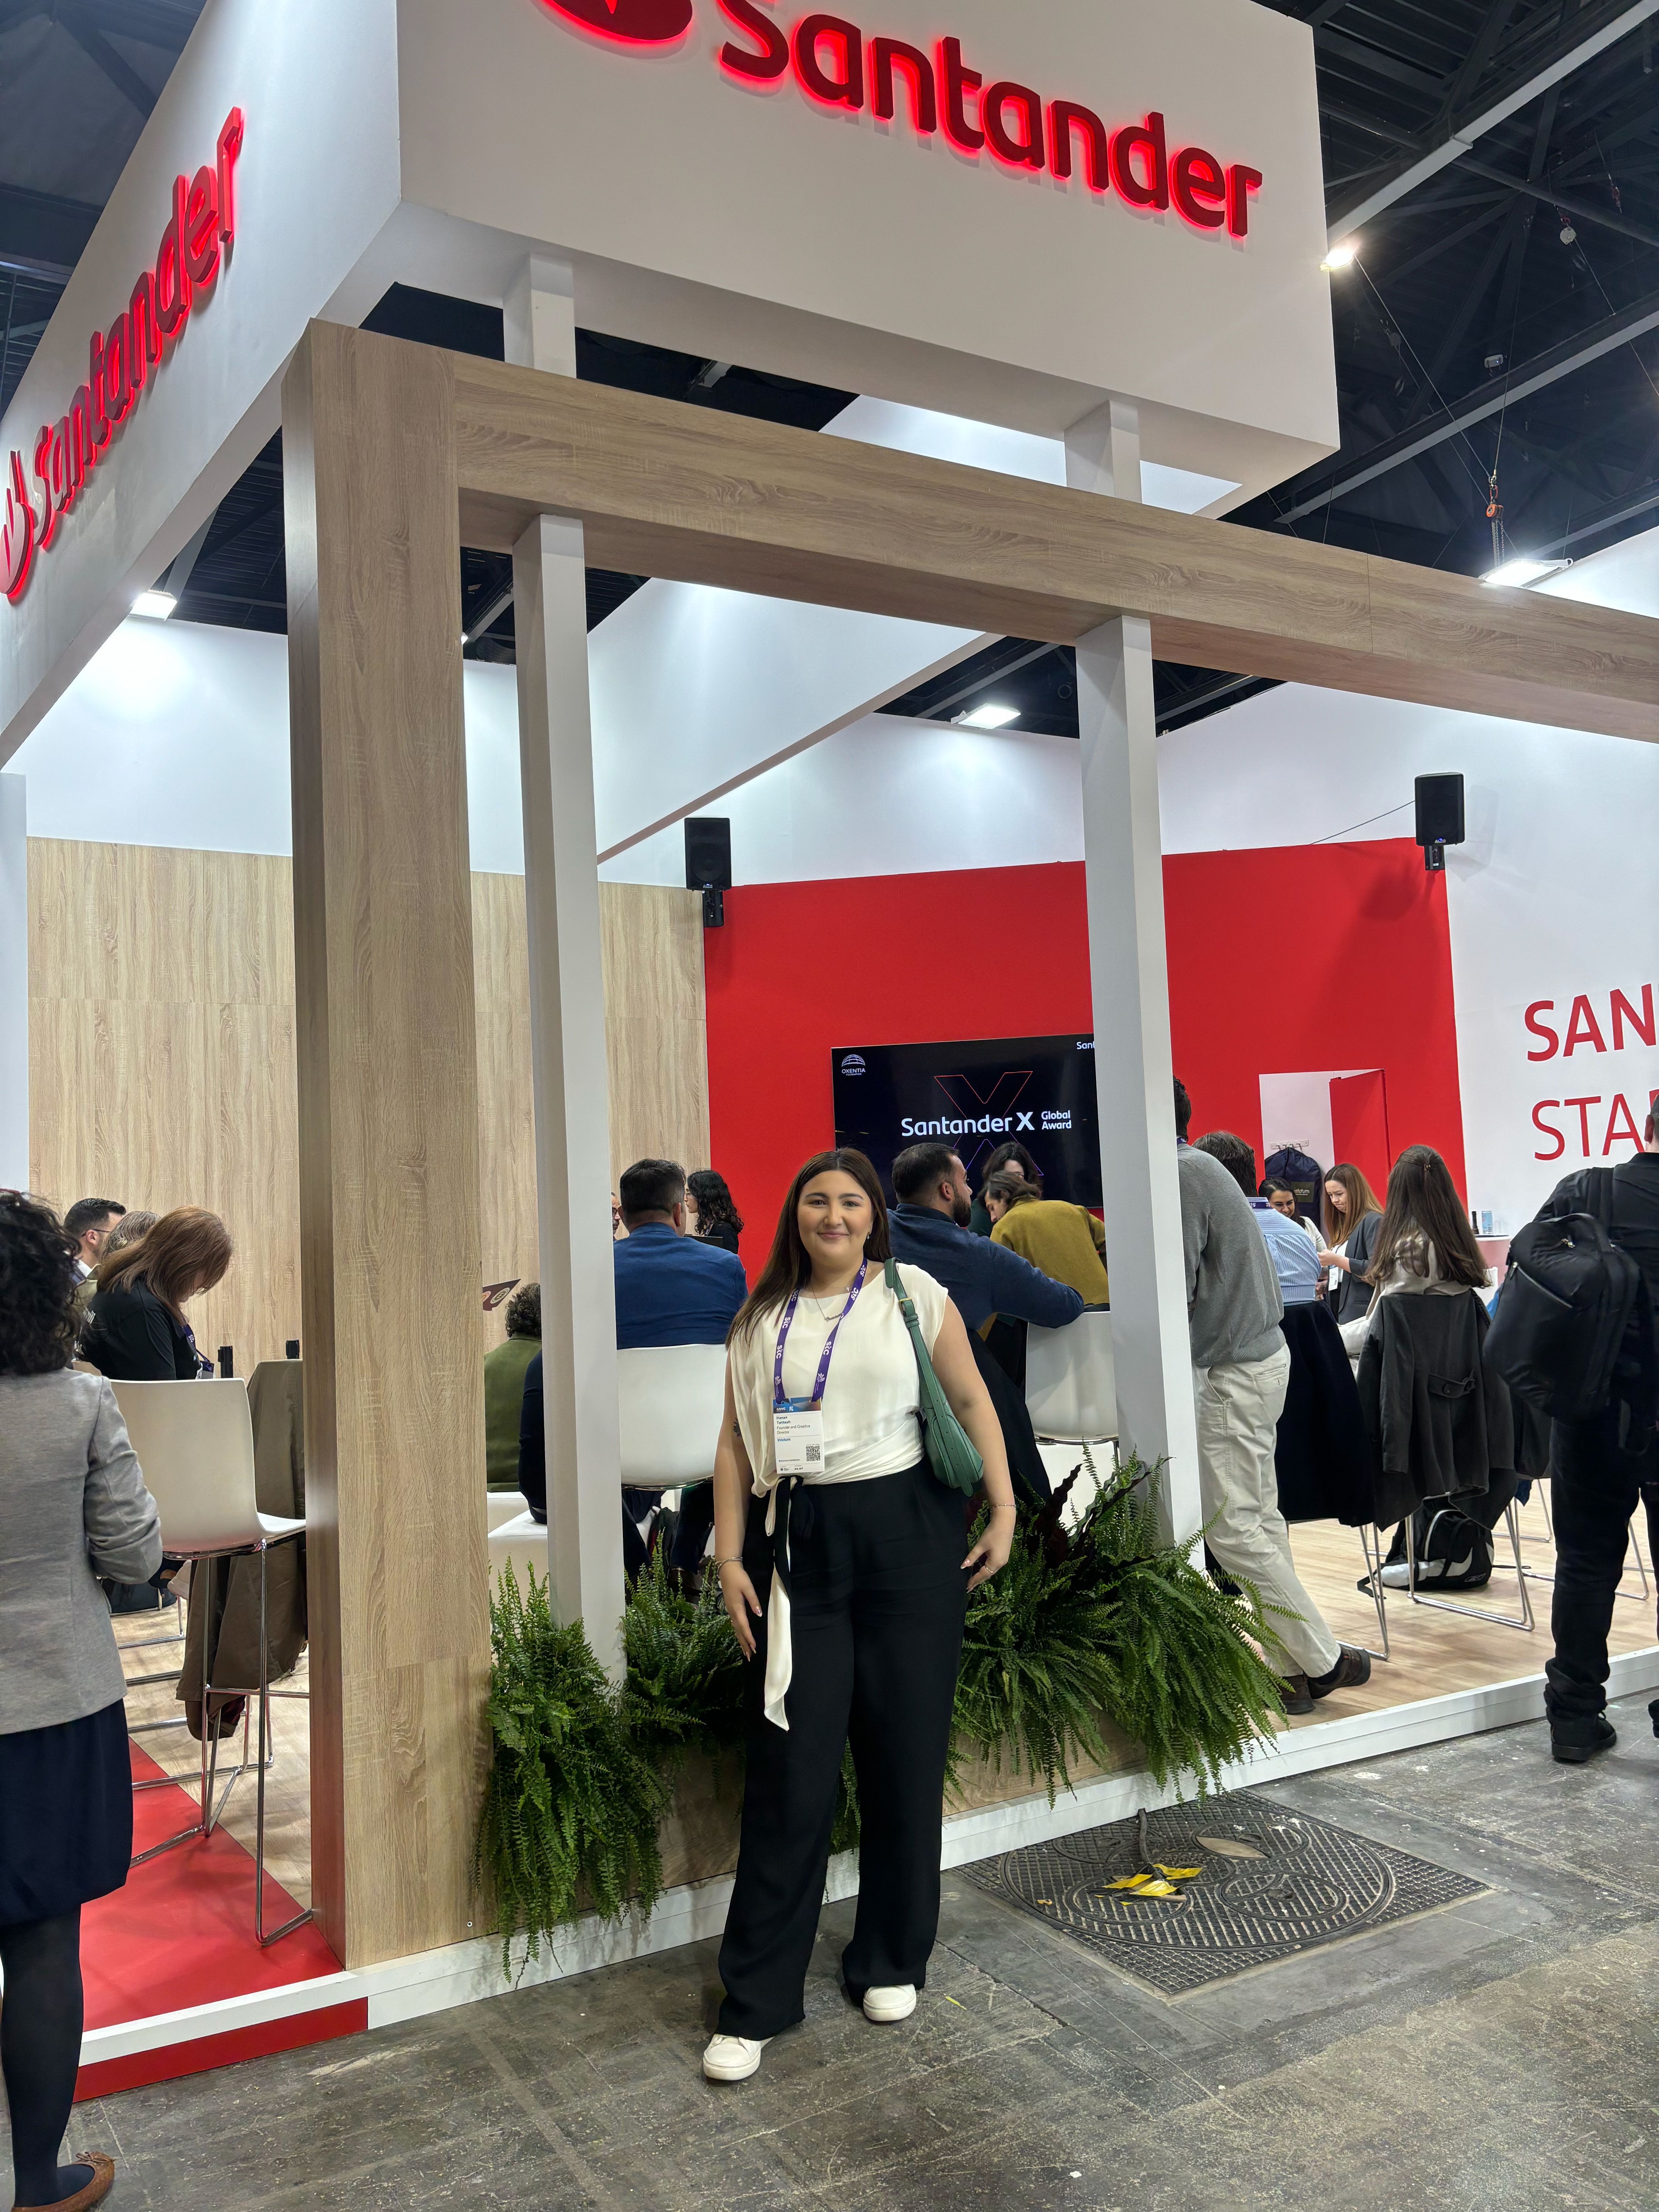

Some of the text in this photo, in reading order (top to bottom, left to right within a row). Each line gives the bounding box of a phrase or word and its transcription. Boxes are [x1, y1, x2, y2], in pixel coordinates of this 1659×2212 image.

[718, 0, 1262, 236] Santander
[34, 106, 243, 546] Santander
[901, 1109, 1071, 1137] Santander X Global
[1042, 1120, 1072, 1130] Award
[1532, 1089, 1659, 1161] STA
